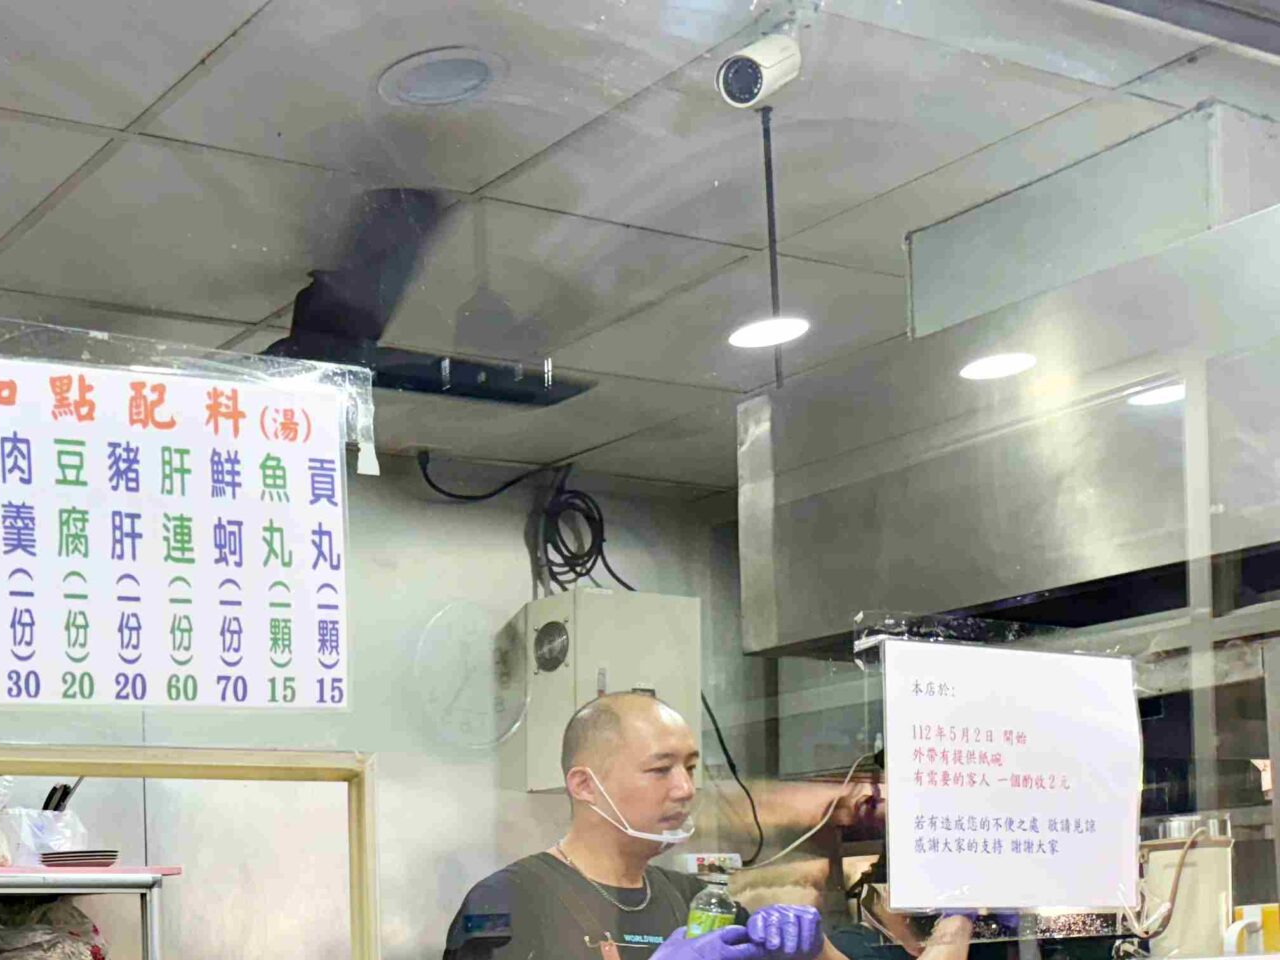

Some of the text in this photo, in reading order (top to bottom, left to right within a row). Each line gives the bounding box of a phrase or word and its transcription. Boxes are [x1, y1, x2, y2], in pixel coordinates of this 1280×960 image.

[6, 668, 41, 699] 30
[61, 671, 95, 700] 20
[114, 672, 147, 701] 20
[166, 674, 198, 702] 60
[216, 675, 248, 702] 70
[266, 676, 297, 703] 15
[315, 677, 345, 704] 15
[912, 724, 995, 744] 112年5月2日
[913, 838, 1060, 856] 感謝大家的支持 謝謝大家
